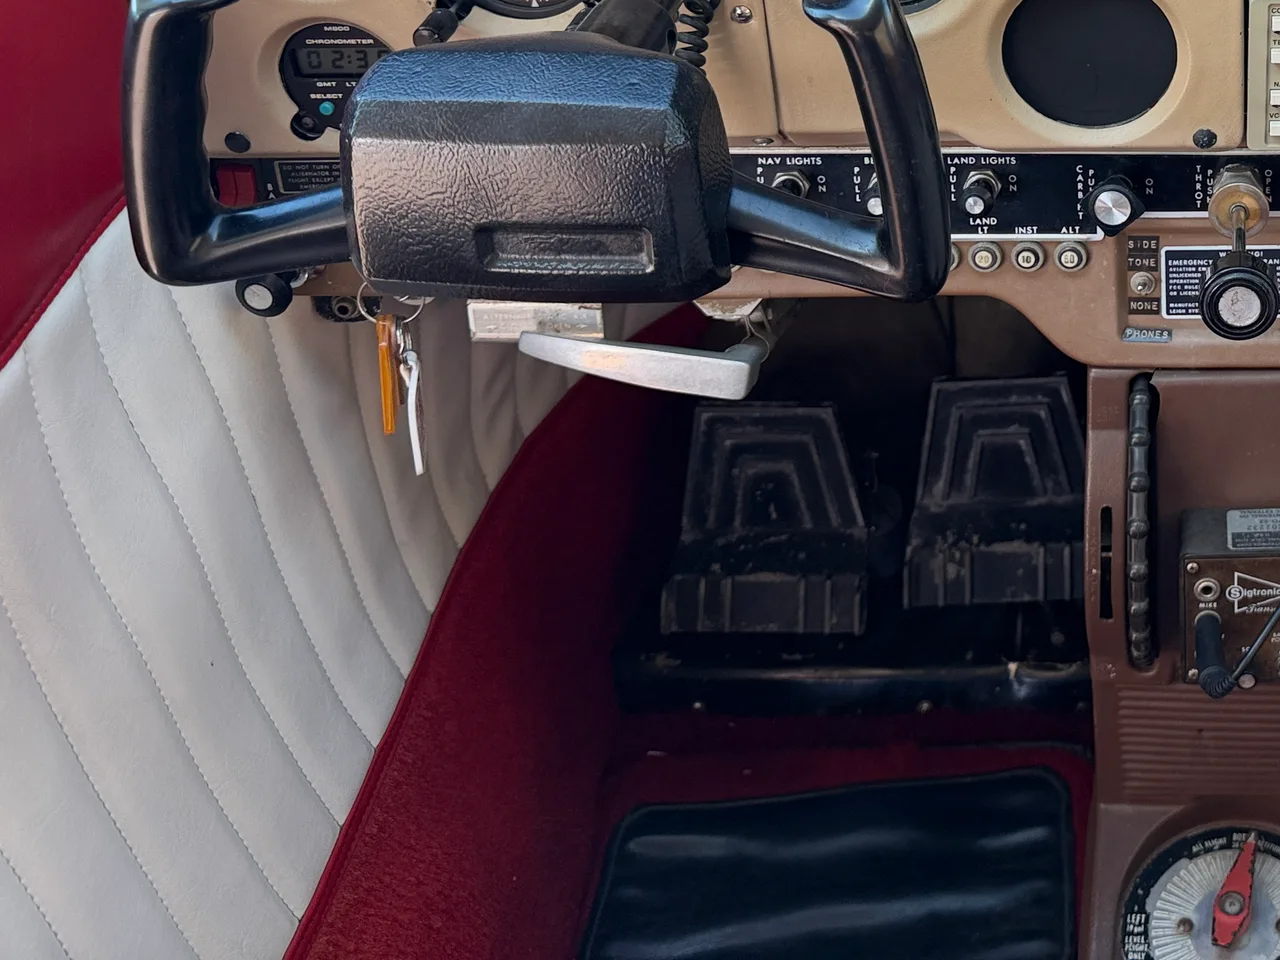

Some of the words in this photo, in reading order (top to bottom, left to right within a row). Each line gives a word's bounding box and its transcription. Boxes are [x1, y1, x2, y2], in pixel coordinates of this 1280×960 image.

[758, 157, 782, 165] NAV
[786, 157, 822, 165] LIGHTS
[947, 157, 976, 165] LAND
[981, 157, 1017, 165] LIGHTS
[854, 167, 862, 202] PULL
[1076, 165, 1084, 199] CARB
[1195, 165, 1203, 208] THROT
[1015, 226, 1038, 234] INST
[1061, 226, 1080, 234] ALT
[1128, 258, 1156, 266] TONE
[1130, 302, 1159, 310] NONE
[1126, 330, 1169, 339] PHONES
[1127, 914, 1146, 924] LEFT
